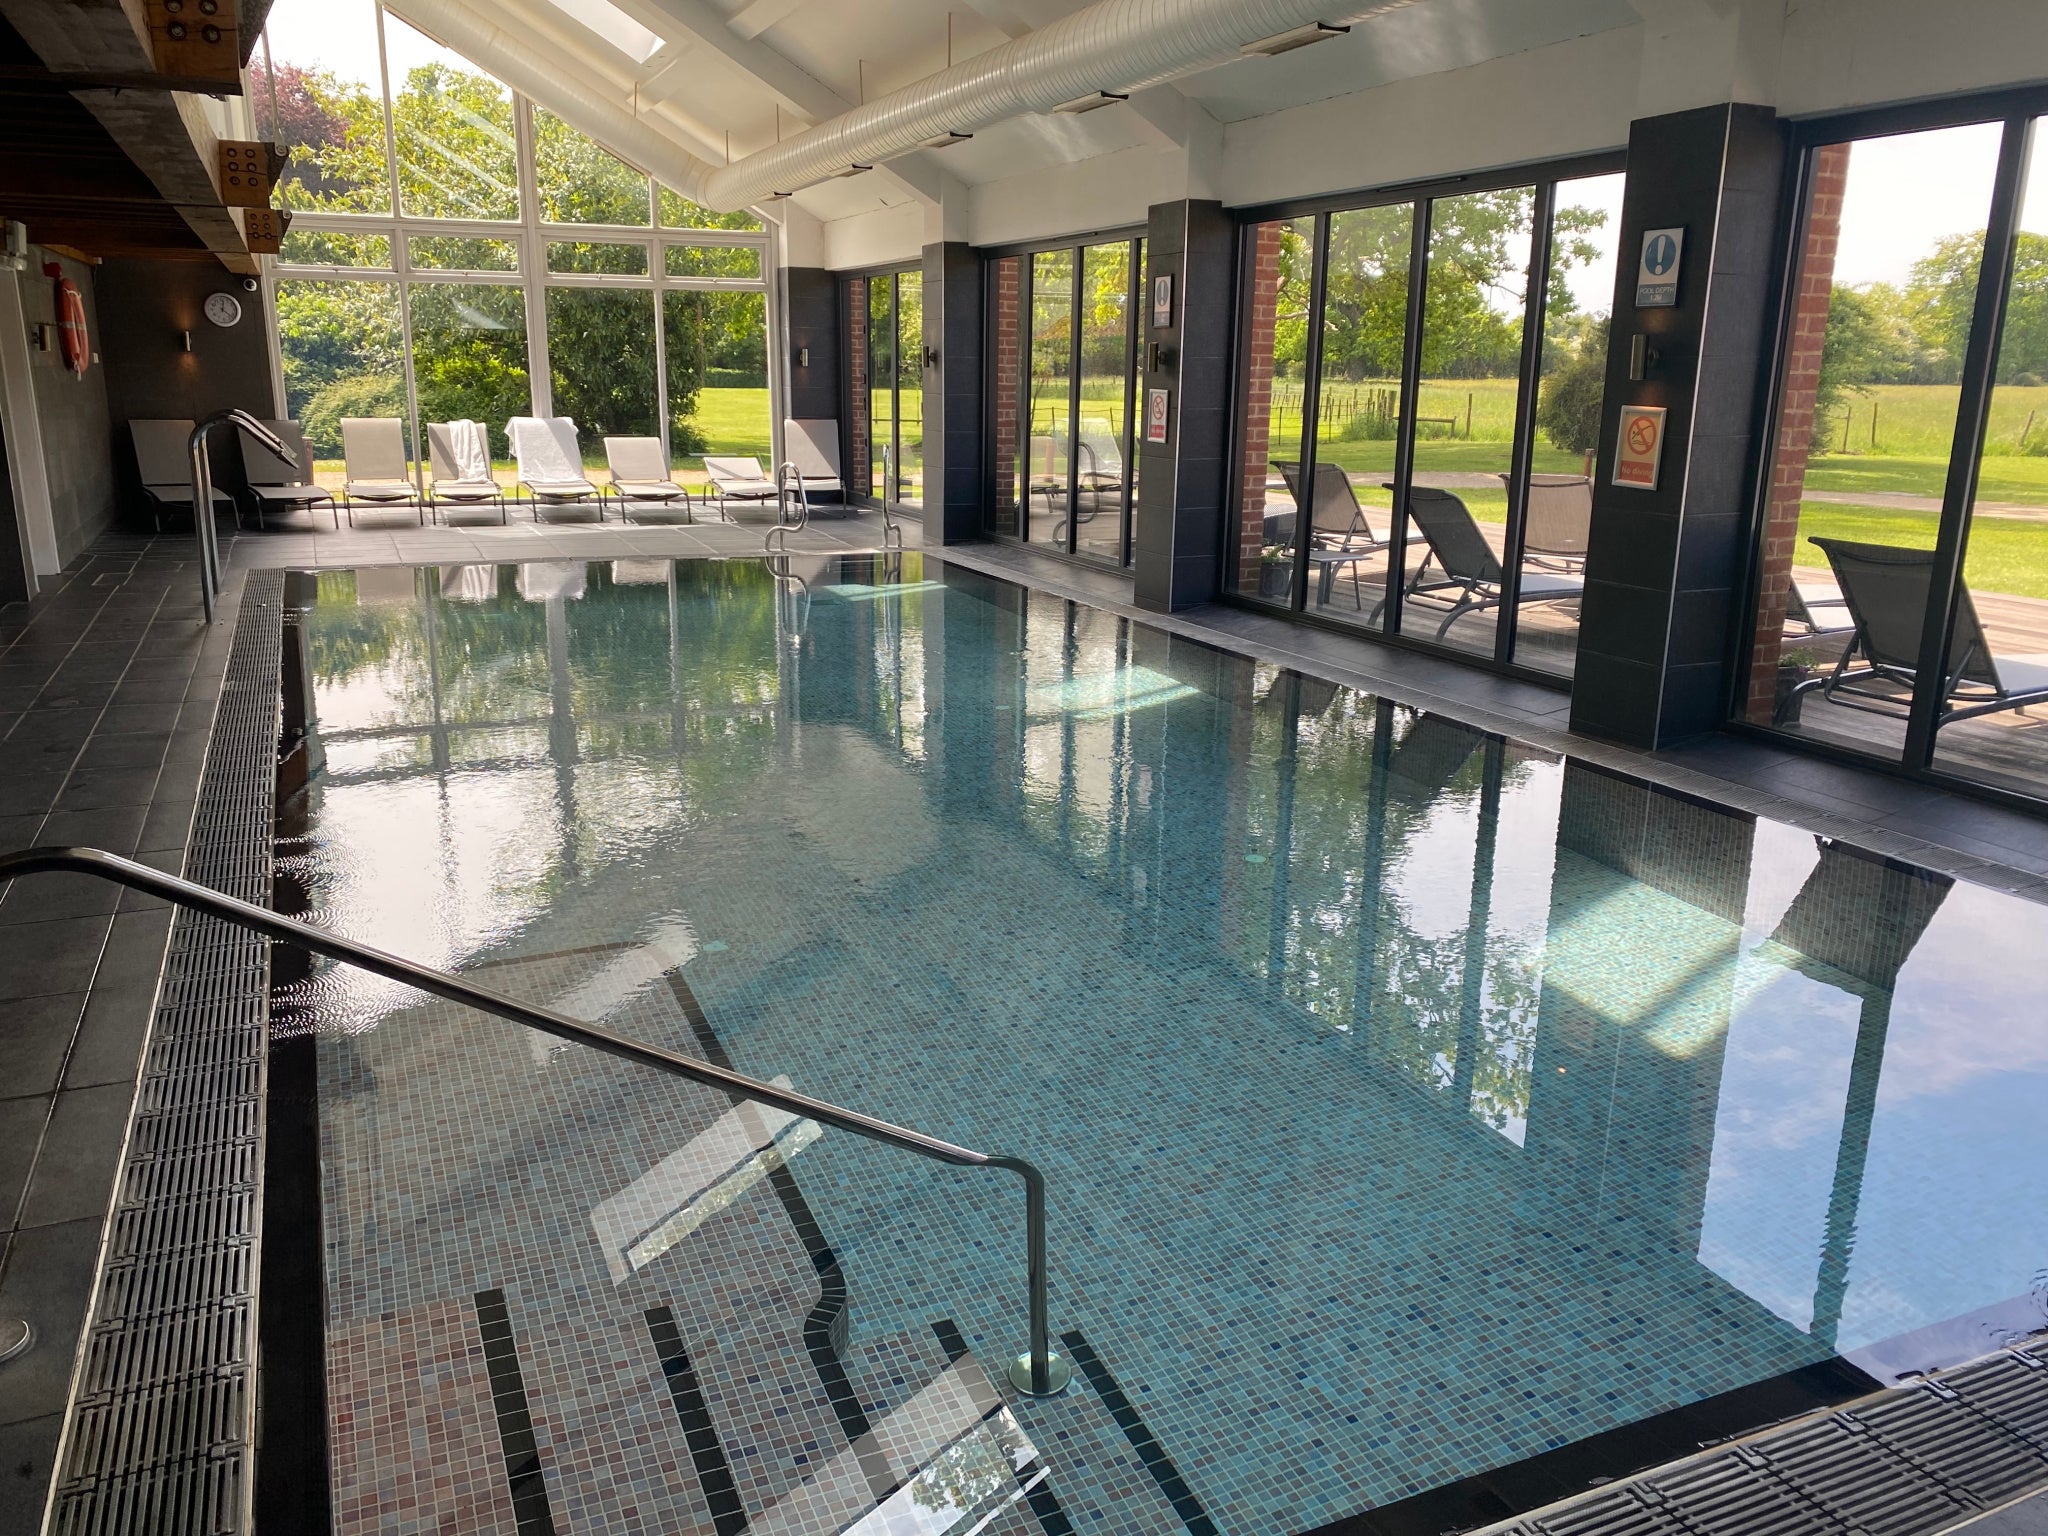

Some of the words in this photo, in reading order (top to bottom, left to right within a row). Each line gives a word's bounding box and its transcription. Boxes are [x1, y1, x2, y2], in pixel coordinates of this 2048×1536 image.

[1656, 286, 1674, 294] DEPTH
[1622, 464, 1632, 474] No
[1632, 466, 1653, 478] diving
